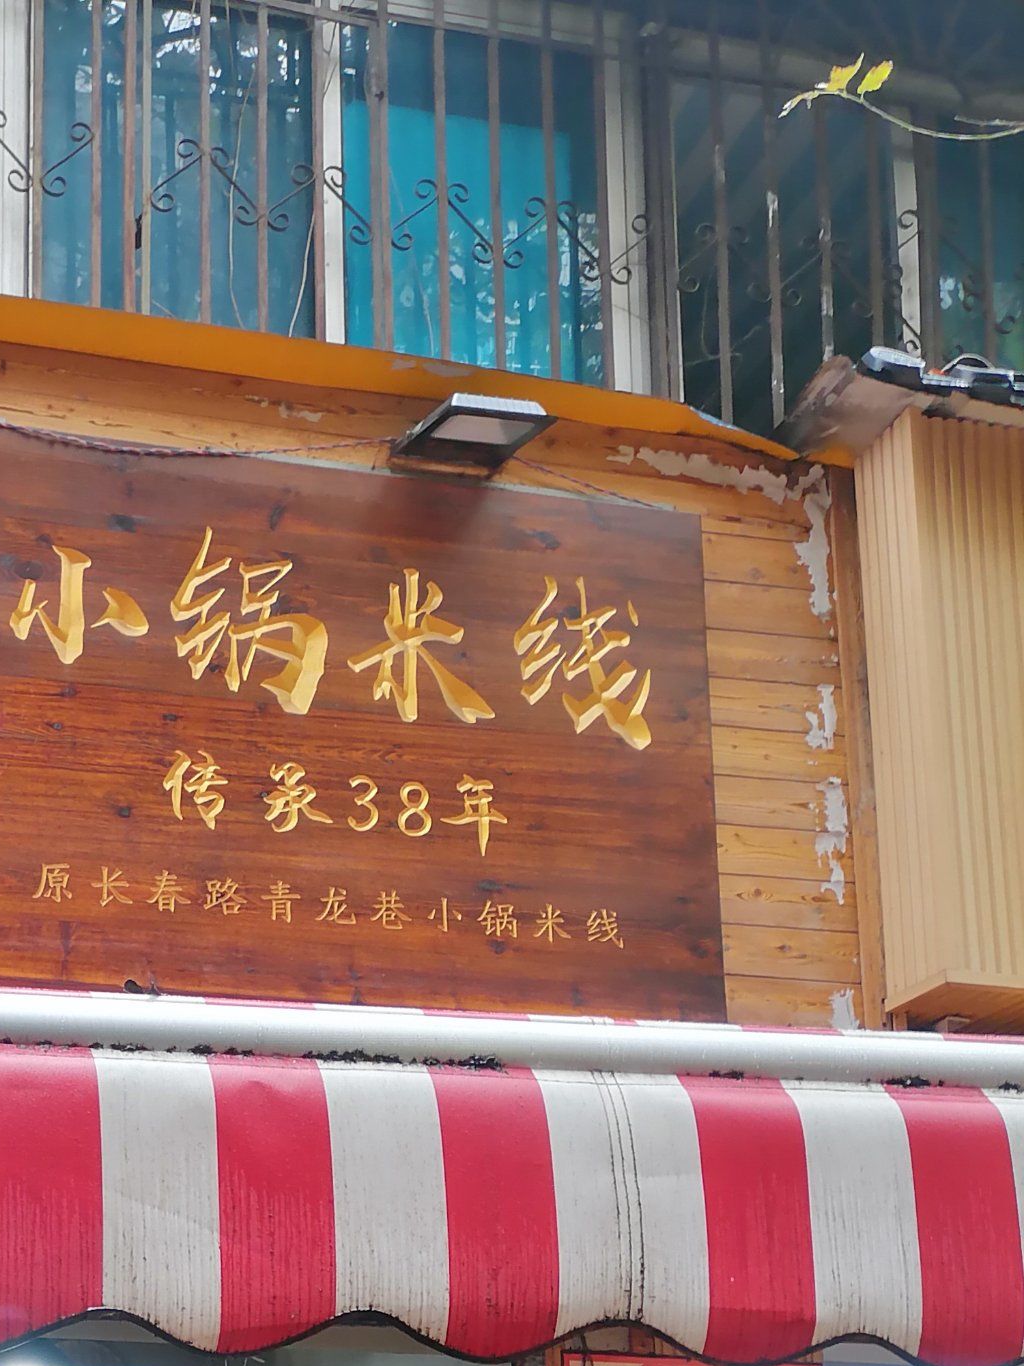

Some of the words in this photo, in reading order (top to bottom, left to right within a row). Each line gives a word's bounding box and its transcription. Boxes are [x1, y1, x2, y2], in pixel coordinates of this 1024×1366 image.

[9, 526, 653, 751] 小锅米线
[163, 750, 508, 857] 传承38年
[32, 862, 625, 950] 原长春路青龙巷小锅米线
